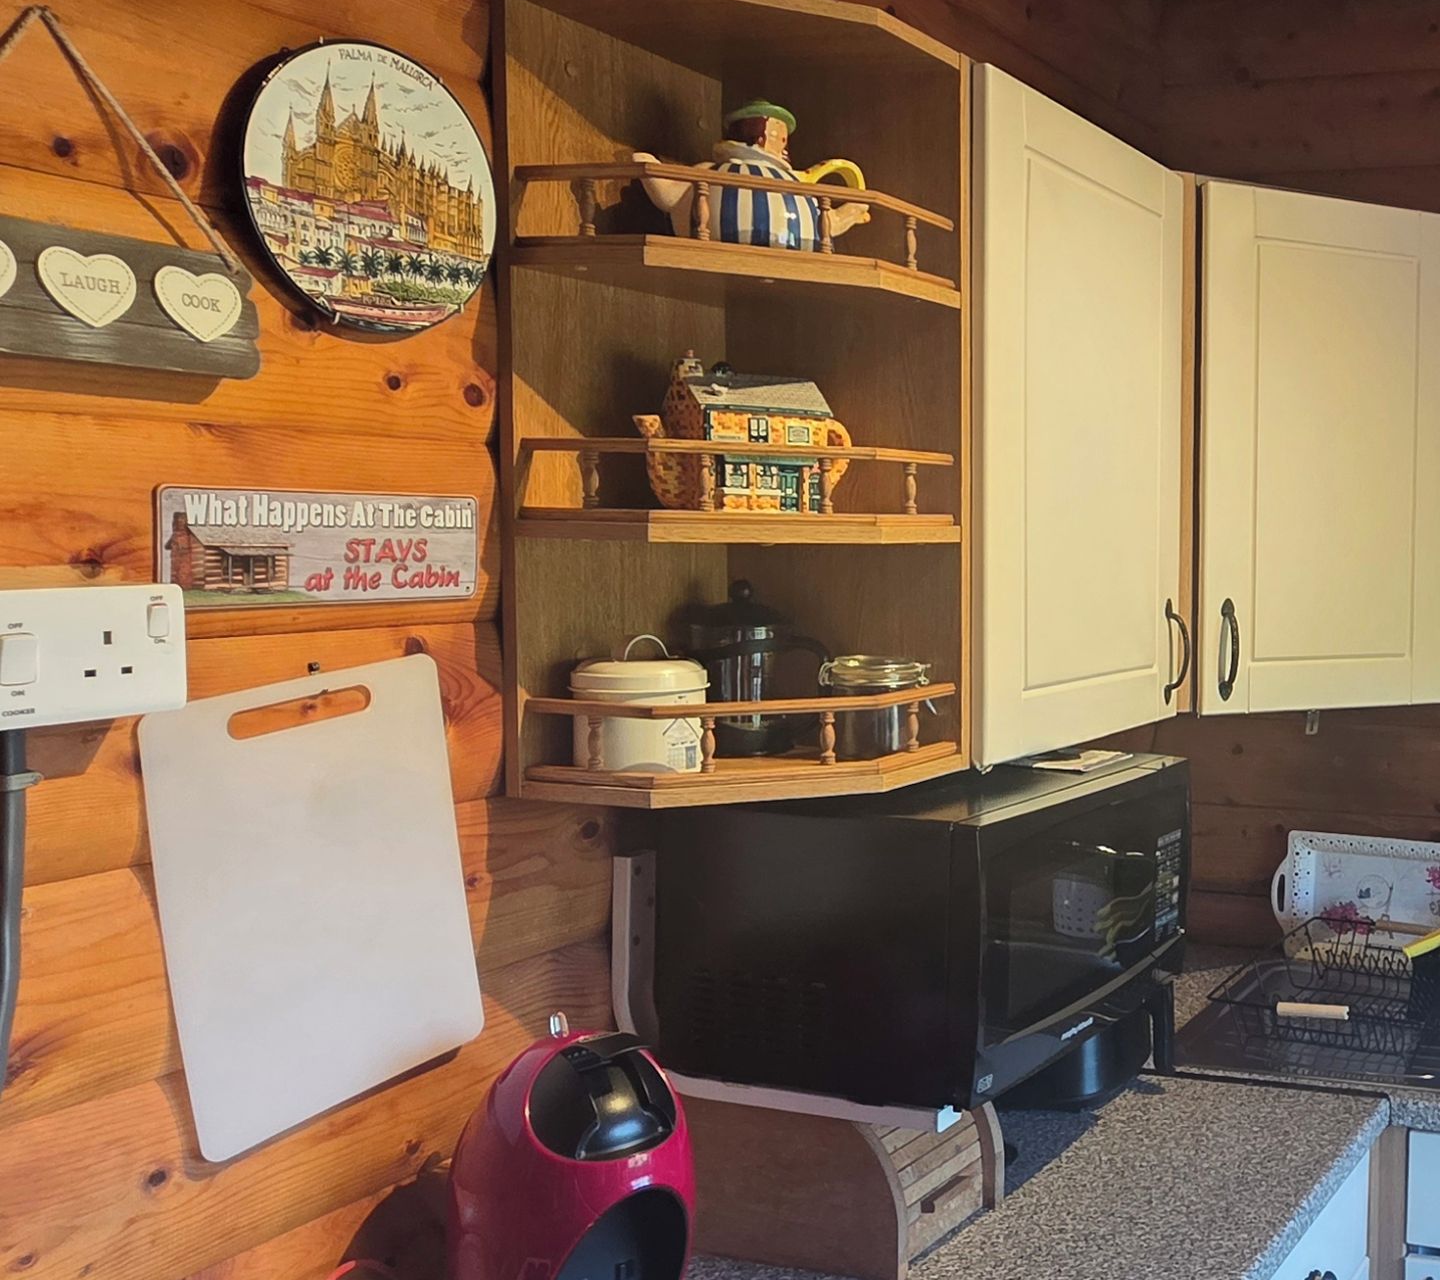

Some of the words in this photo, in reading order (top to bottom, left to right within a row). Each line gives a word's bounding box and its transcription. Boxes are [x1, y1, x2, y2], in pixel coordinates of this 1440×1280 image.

[338, 48, 372, 62] PALMA
[389, 57, 433, 91] MALLORCA
[59, 271, 121, 295] LAUGH
[181, 293, 222, 313] COOK
[184, 493, 248, 528] What
[252, 494, 348, 533] Happens
[349, 501, 379, 528] At
[379, 504, 417, 529] The
[418, 504, 474, 529] Cabin
[343, 538, 428, 564] STAYS
[304, 569, 334, 592] at
[343, 567, 381, 592] the
[391, 563, 460, 589] Cabin
[2, 707, 36, 717] COOKER
